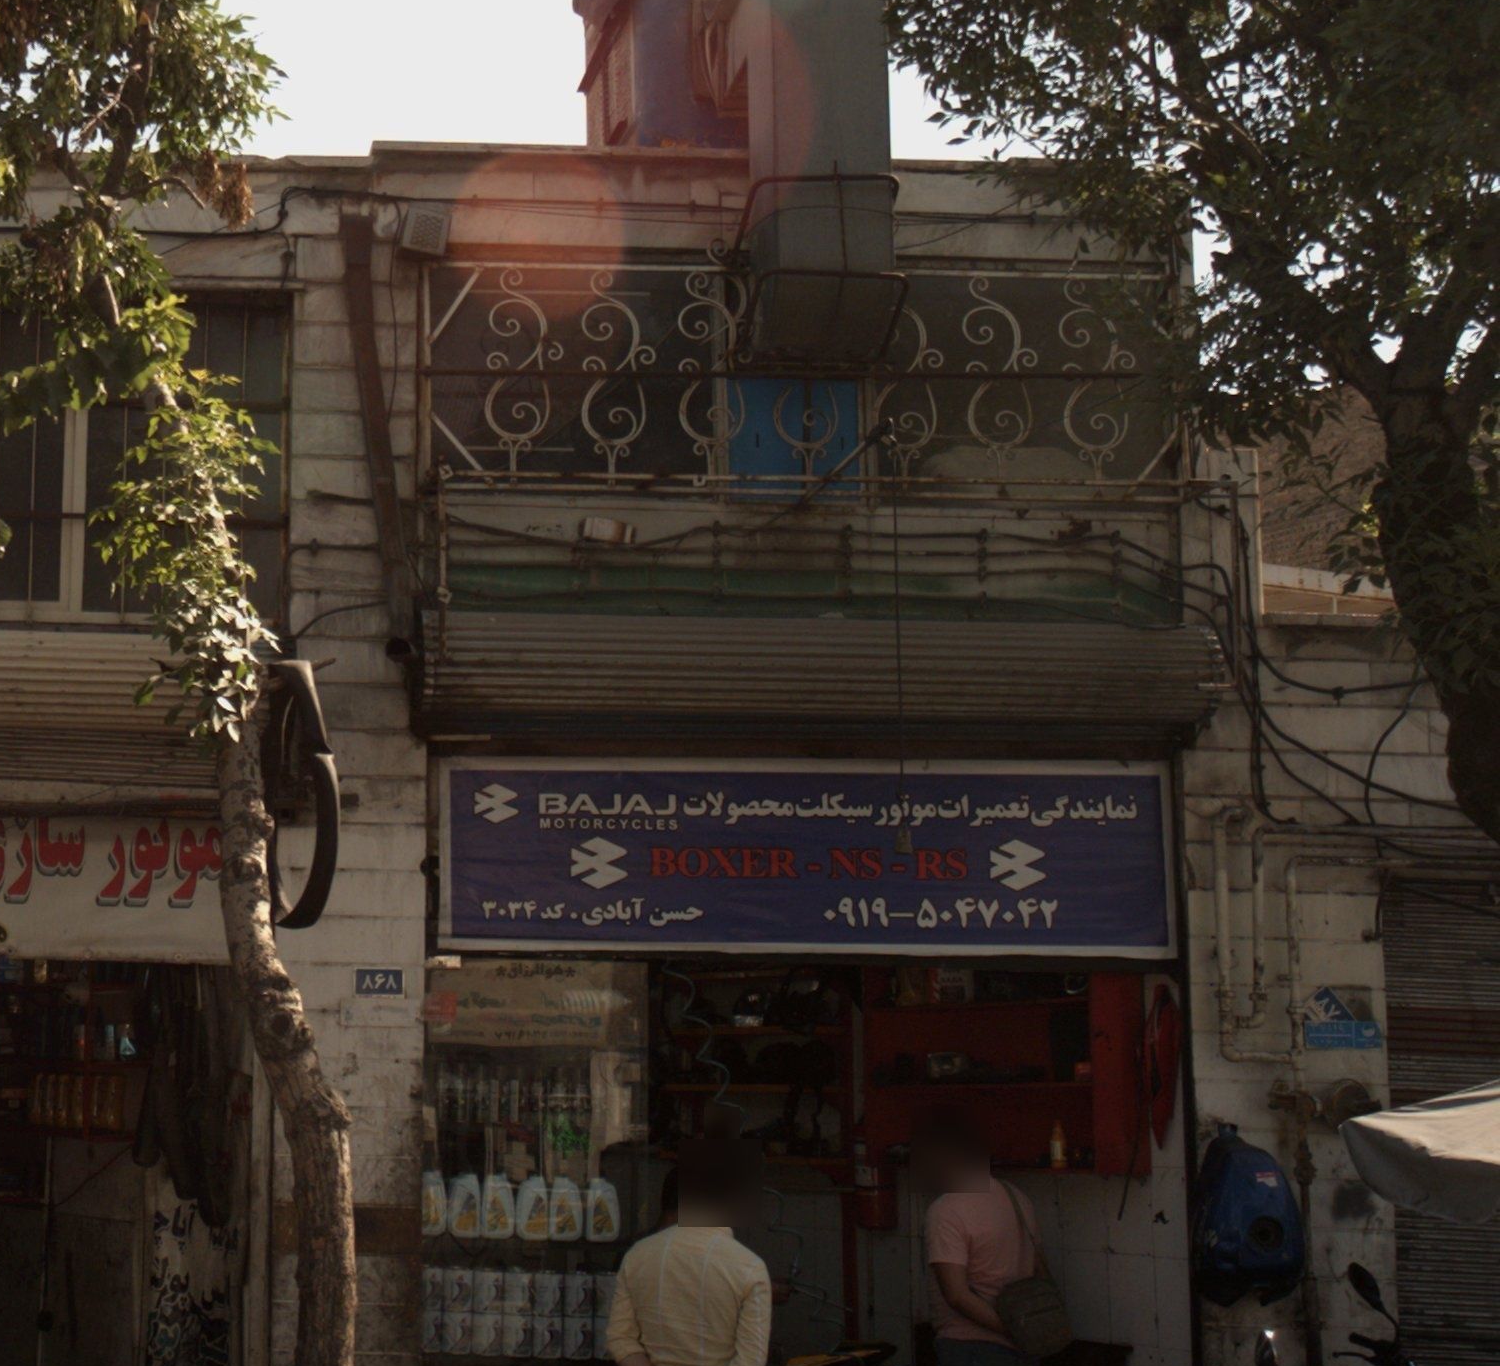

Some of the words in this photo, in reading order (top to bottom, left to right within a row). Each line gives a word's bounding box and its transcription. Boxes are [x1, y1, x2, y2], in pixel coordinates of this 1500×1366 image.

[538, 793, 677, 815] BAJAJ
[683, 791, 796, 825] محصولات
[938, 793, 1030, 826] تعمیرات
[1030, 794, 1138, 826] نمایندگی
[539, 817, 679, 830] MOTORCYCLES
[650, 846, 799, 878] BOXER
[829, 847, 883, 879] NS
[915, 847, 969, 880] RS
[481, 899, 537, 921] ۳۰۳۴
[540, 901, 566, 921] کد
[649, 902, 704, 927] حسن
[362, 972, 398, 990] ۸۶۸
